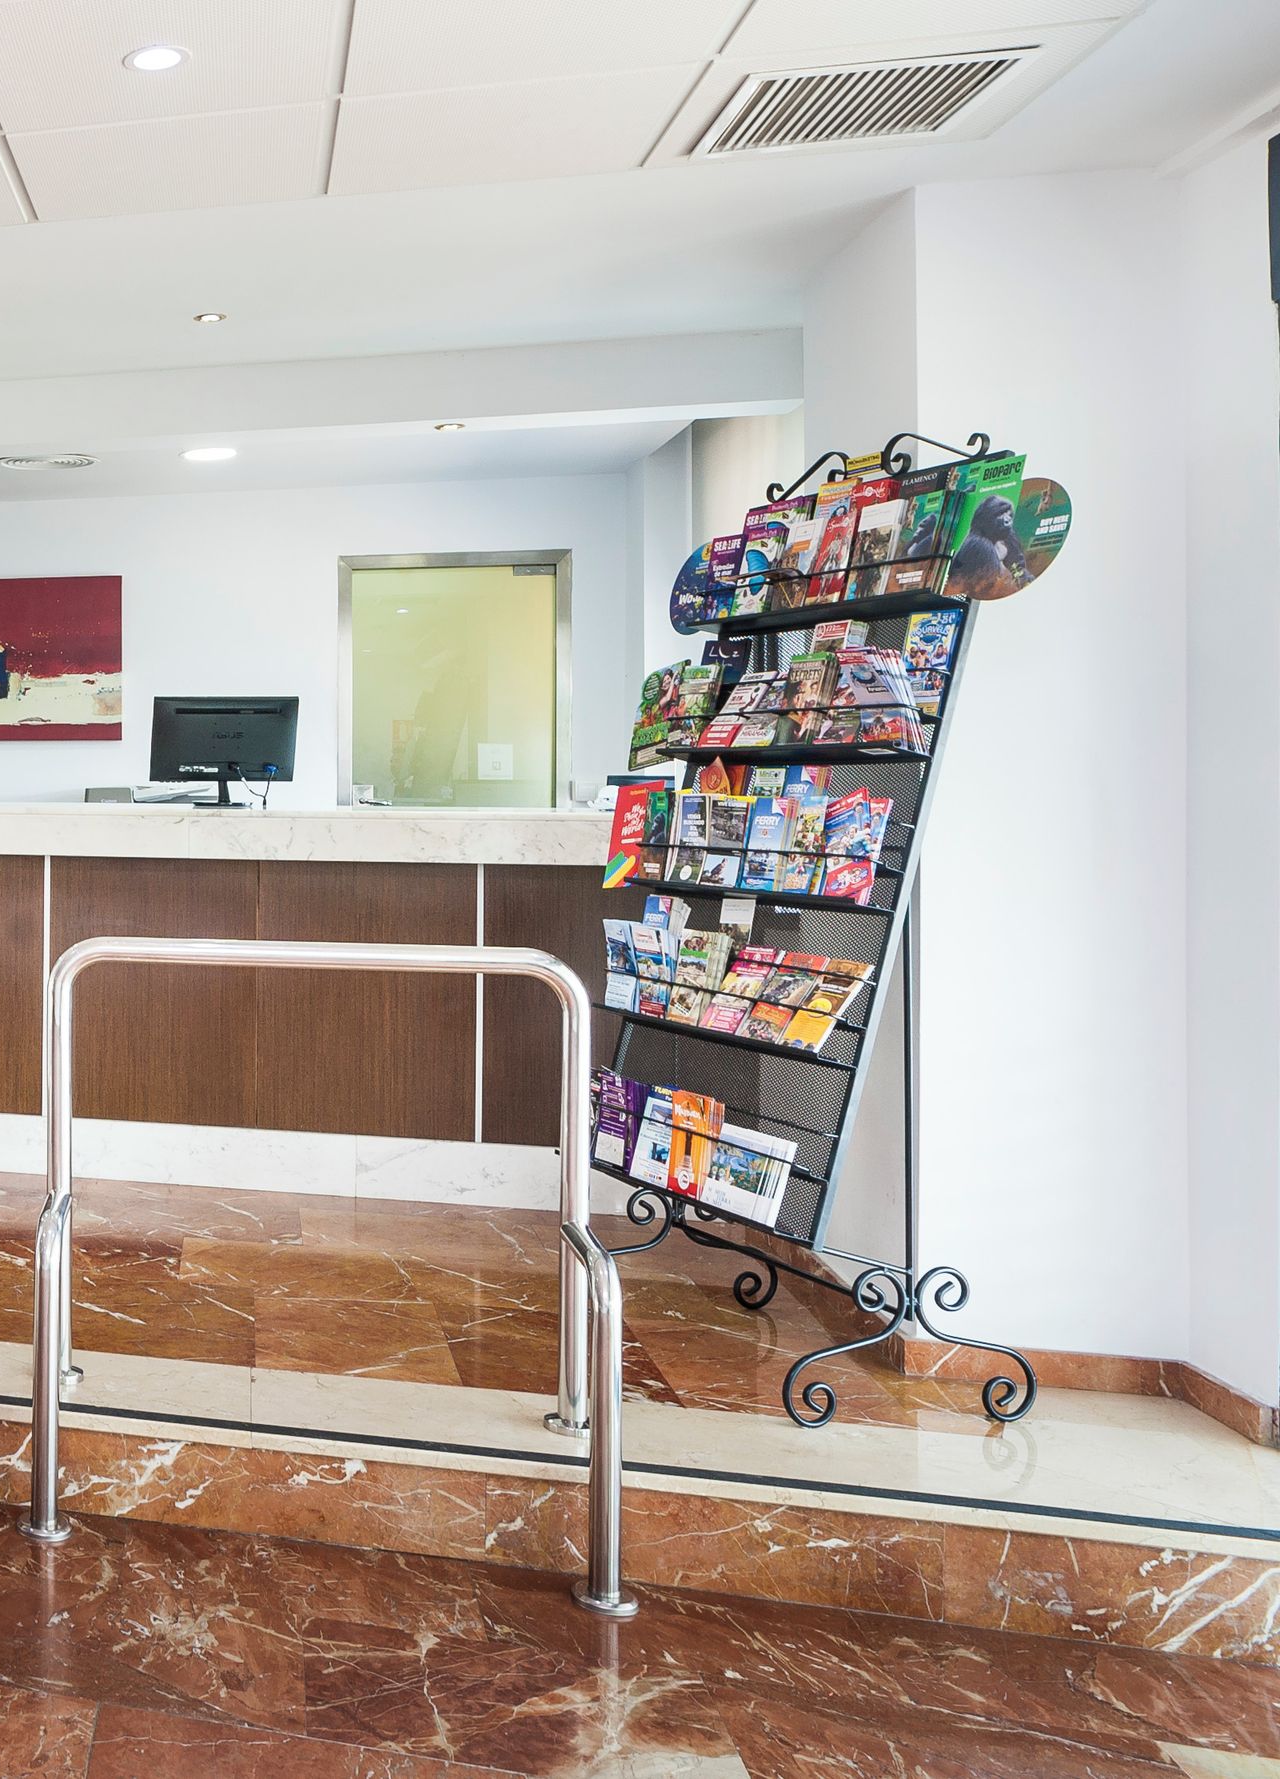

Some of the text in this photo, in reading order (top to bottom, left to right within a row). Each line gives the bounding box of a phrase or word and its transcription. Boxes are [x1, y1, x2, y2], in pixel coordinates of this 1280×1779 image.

[902, 472, 938, 486] FLAMENCO
[746, 515, 760, 526] SEA
[714, 539, 741, 552] SEA LIFE
[790, 668, 822, 680] SECRETS
[785, 784, 809, 794] FERRY
[754, 816, 780, 826] FERRY
[645, 913, 664, 922] FERRY
